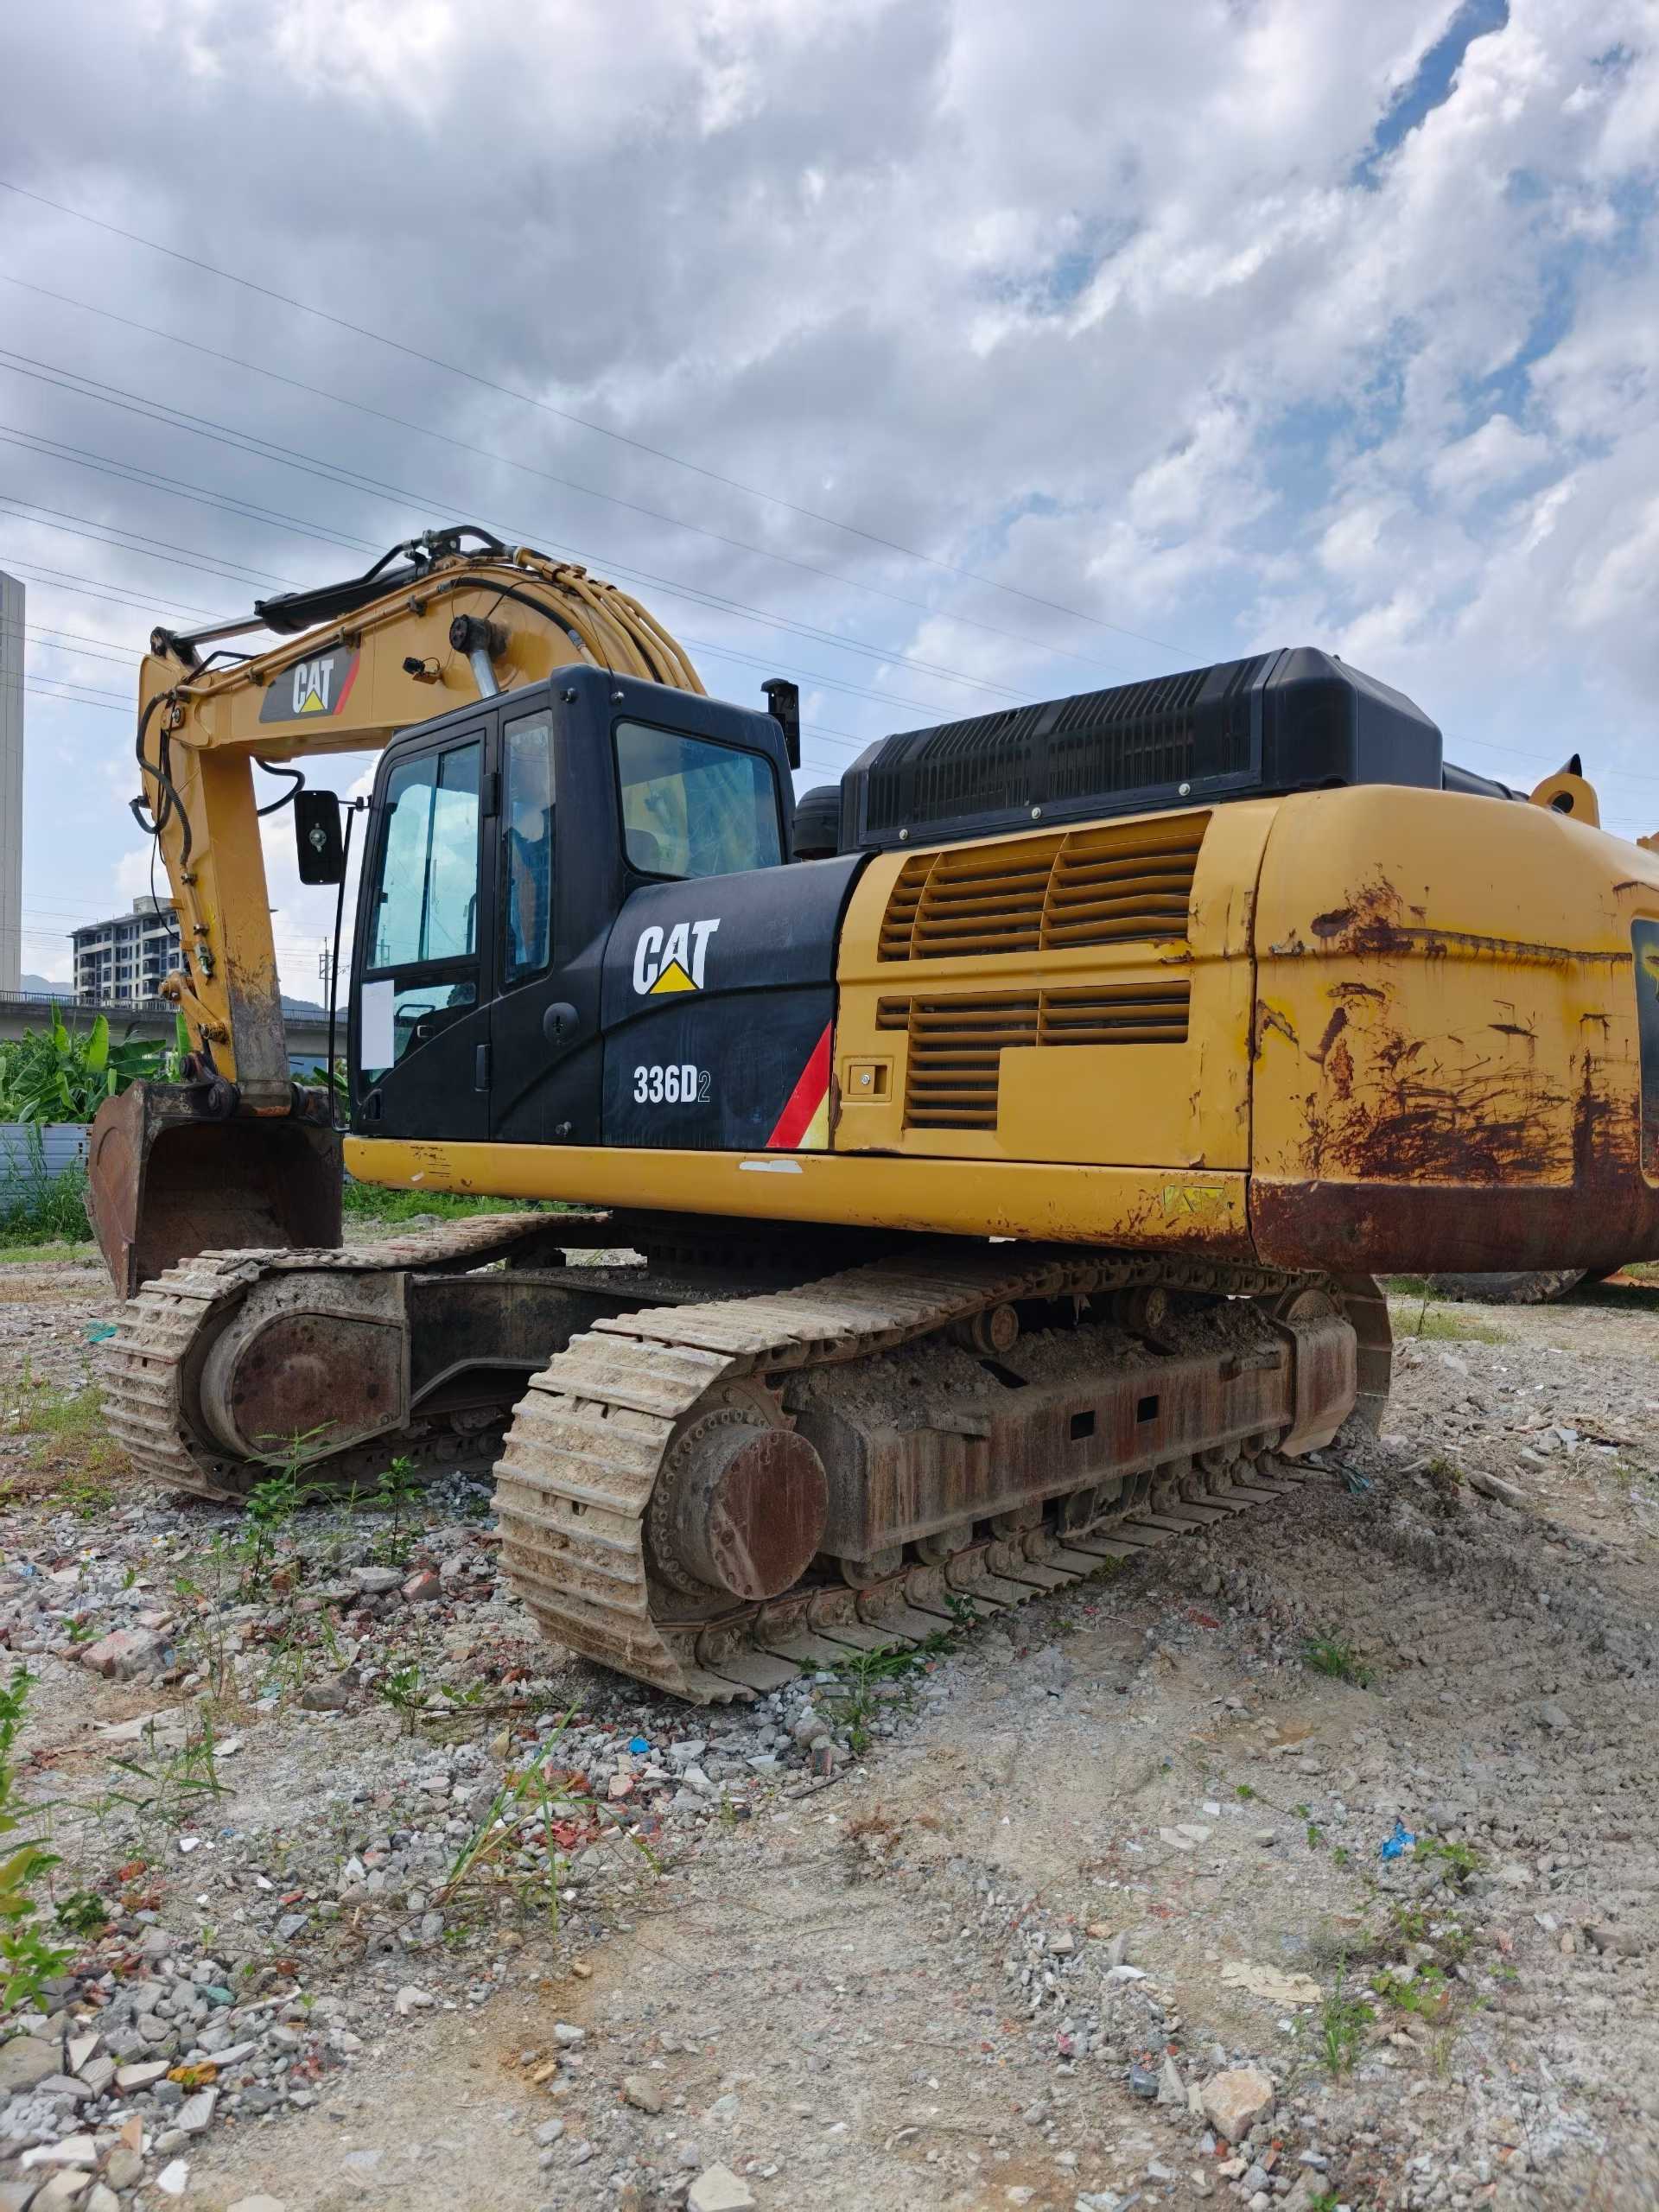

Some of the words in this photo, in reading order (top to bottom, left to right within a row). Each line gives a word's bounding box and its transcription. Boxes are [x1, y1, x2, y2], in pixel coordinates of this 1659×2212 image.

[293, 659, 334, 714] CAT
[632, 918, 721, 995] CAT
[633, 1065, 712, 1103] 336D2
